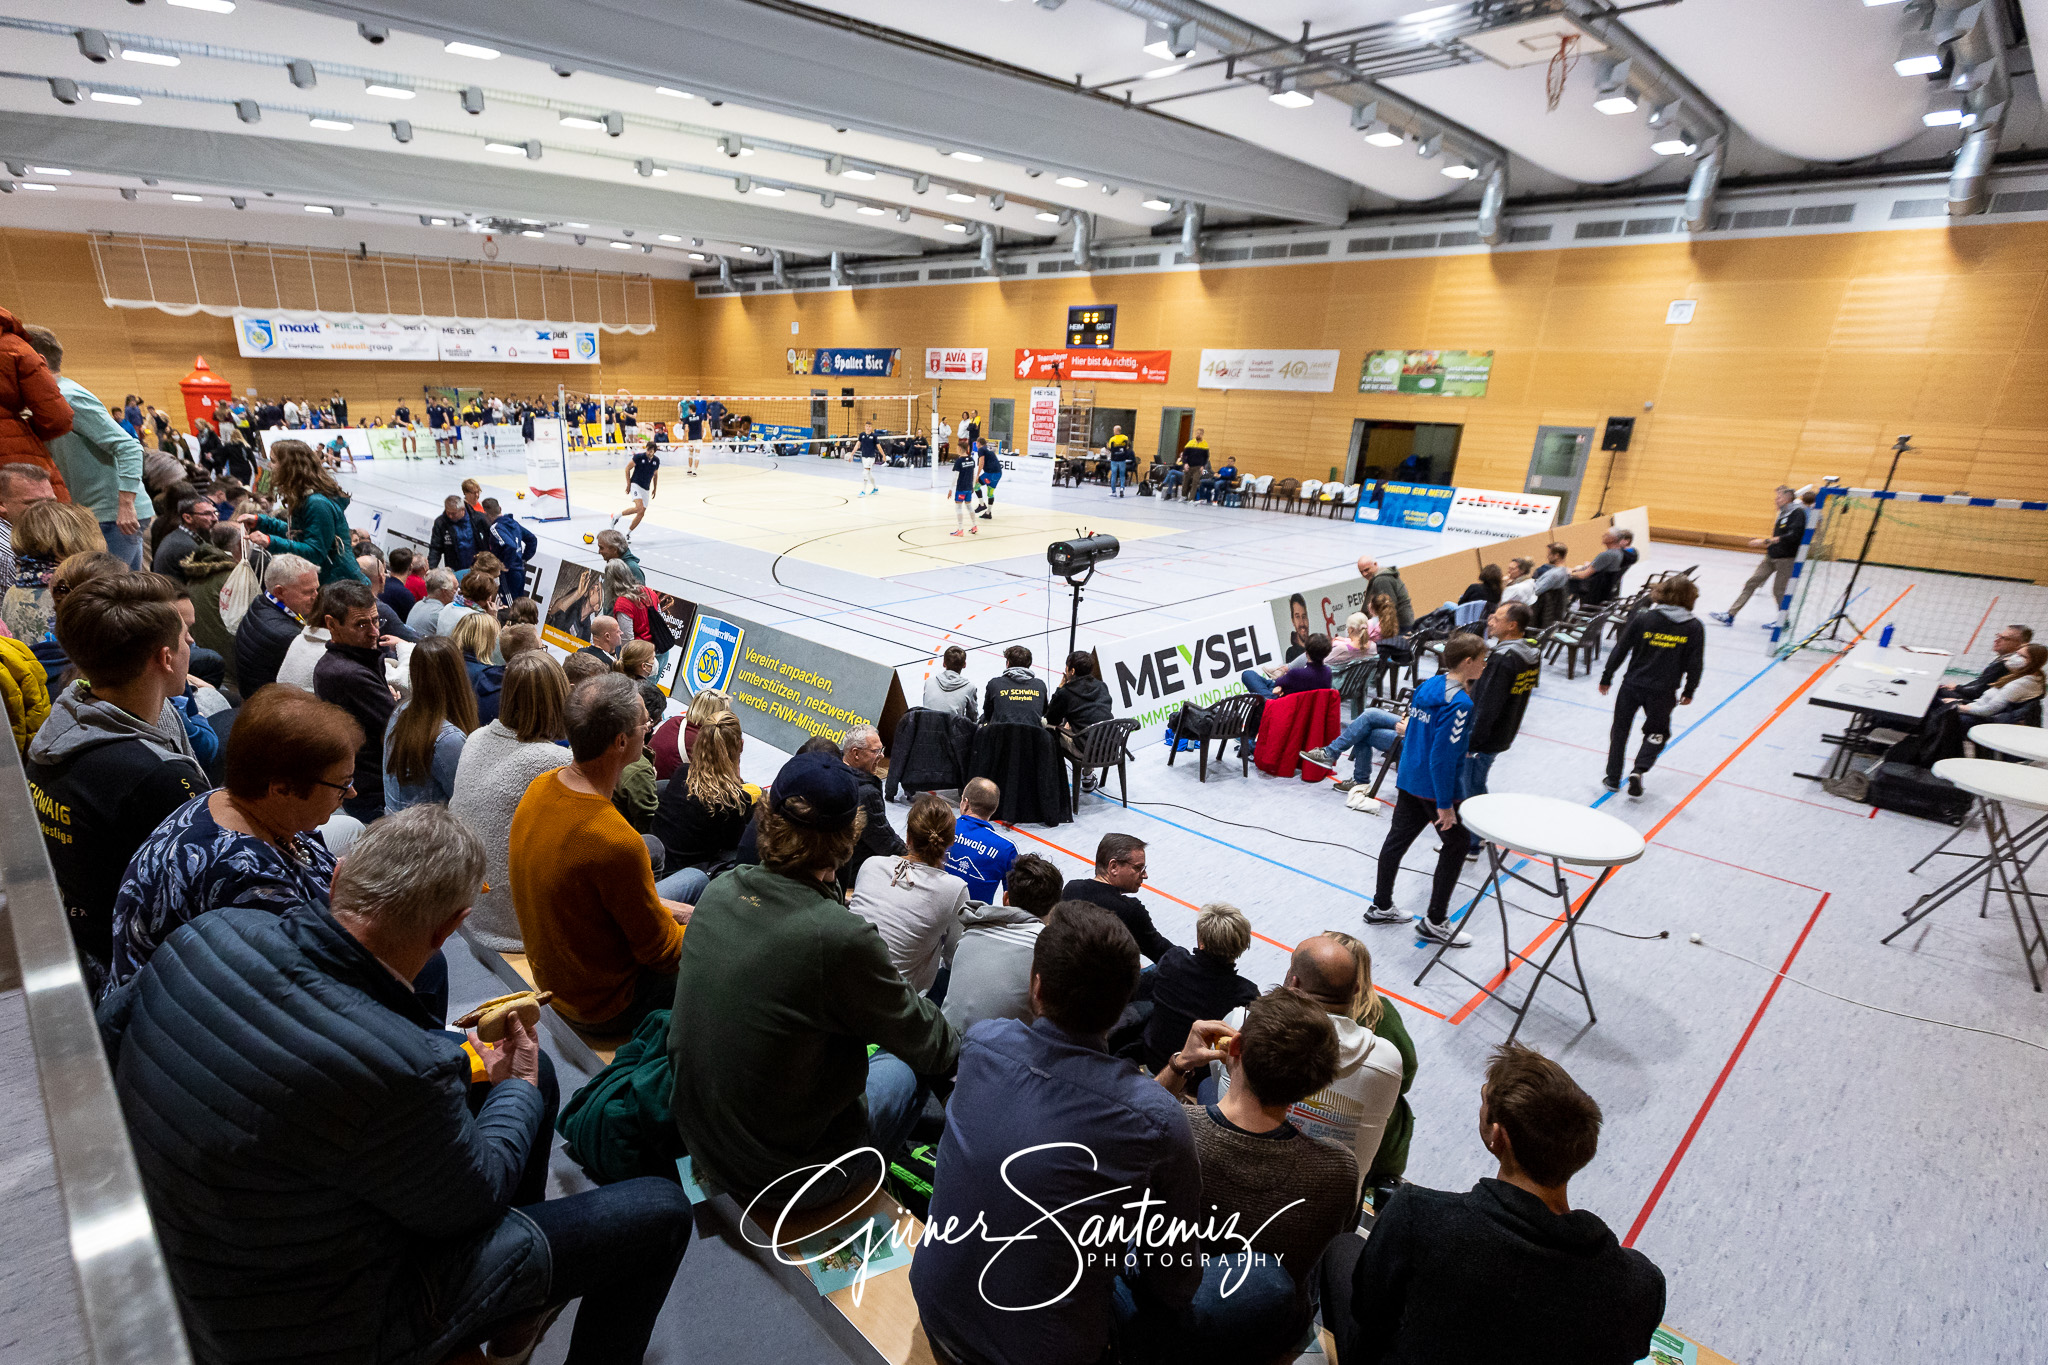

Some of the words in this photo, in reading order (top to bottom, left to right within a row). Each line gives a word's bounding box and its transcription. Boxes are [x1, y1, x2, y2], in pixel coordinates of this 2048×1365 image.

[279, 322, 321, 334] maxit
[442, 327, 477, 336] MEYSEL
[1069, 323, 1085, 331] HEIM
[1095, 322, 1112, 331] GAST
[834, 353, 864, 373] Spalter
[865, 353, 884, 371] Bier
[945, 349, 967, 363] AVIA
[1071, 355, 1087, 366] Hier
[1087, 356, 1101, 367] bist
[1102, 356, 1112, 367] du
[1113, 356, 1139, 370] richtig.
[1033, 389, 1057, 397] MEYSEL
[1412, 486, 1426, 496] EIN
[745, 646, 780, 671] Vereint
[779, 662, 833, 695] anpacken,
[1114, 625, 1273, 709] MEYSEL
[738, 669, 802, 706] unterstützen,
[1000, 689, 1009, 697] SV
[1010, 688, 1040, 698] SCHWAIG
[1194, 688, 1222, 708] UND
[1224, 681, 1250, 701] HOL
[738, 690, 769, 712] werde
[768, 701, 847, 745] FNW-Mitglied!
[1409, 703, 1431, 724] AYERN
[28, 779, 71, 826] HWAIG
[954, 833, 987, 855] chwaig
[987, 846, 999, 859] III
